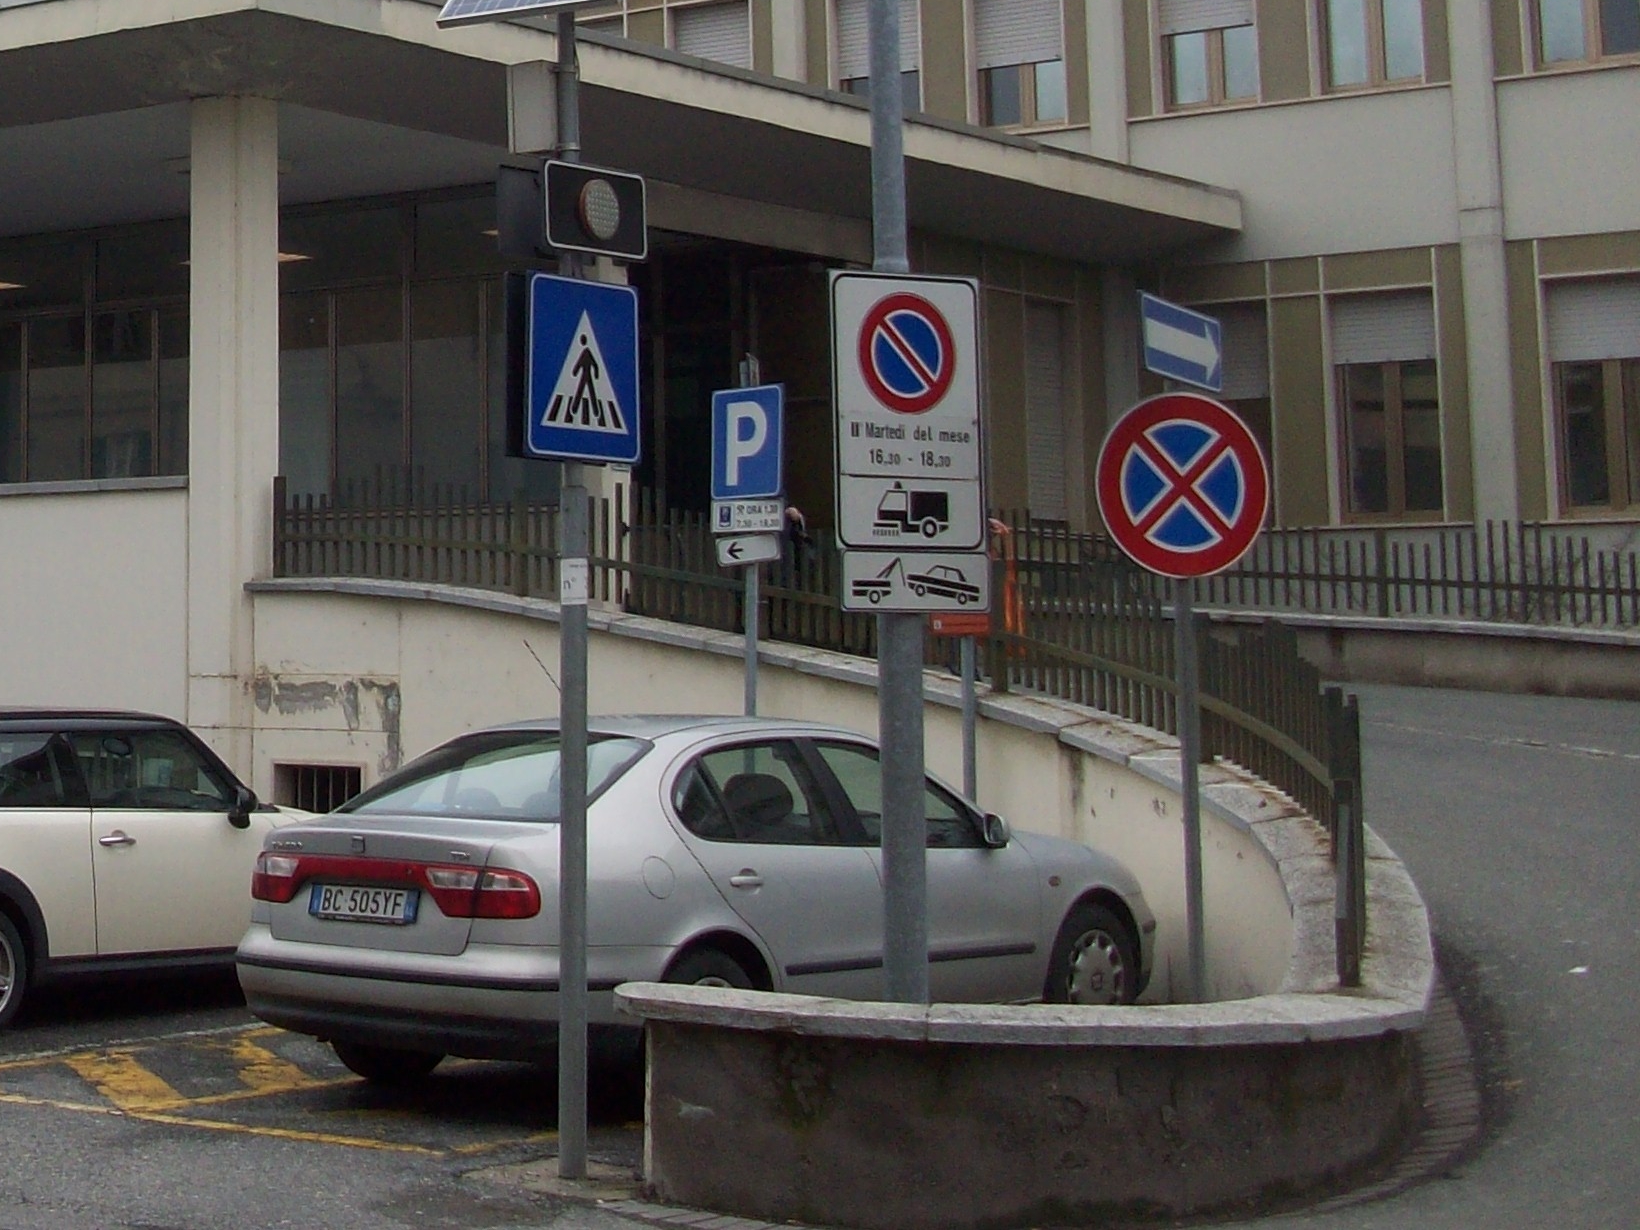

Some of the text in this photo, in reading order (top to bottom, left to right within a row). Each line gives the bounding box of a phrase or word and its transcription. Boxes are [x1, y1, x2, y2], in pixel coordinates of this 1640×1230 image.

[726, 401, 768, 487] P
[913, 426, 933, 441] del
[939, 430, 970, 443] mese
[322, 887, 404, 917] BC 505YF
